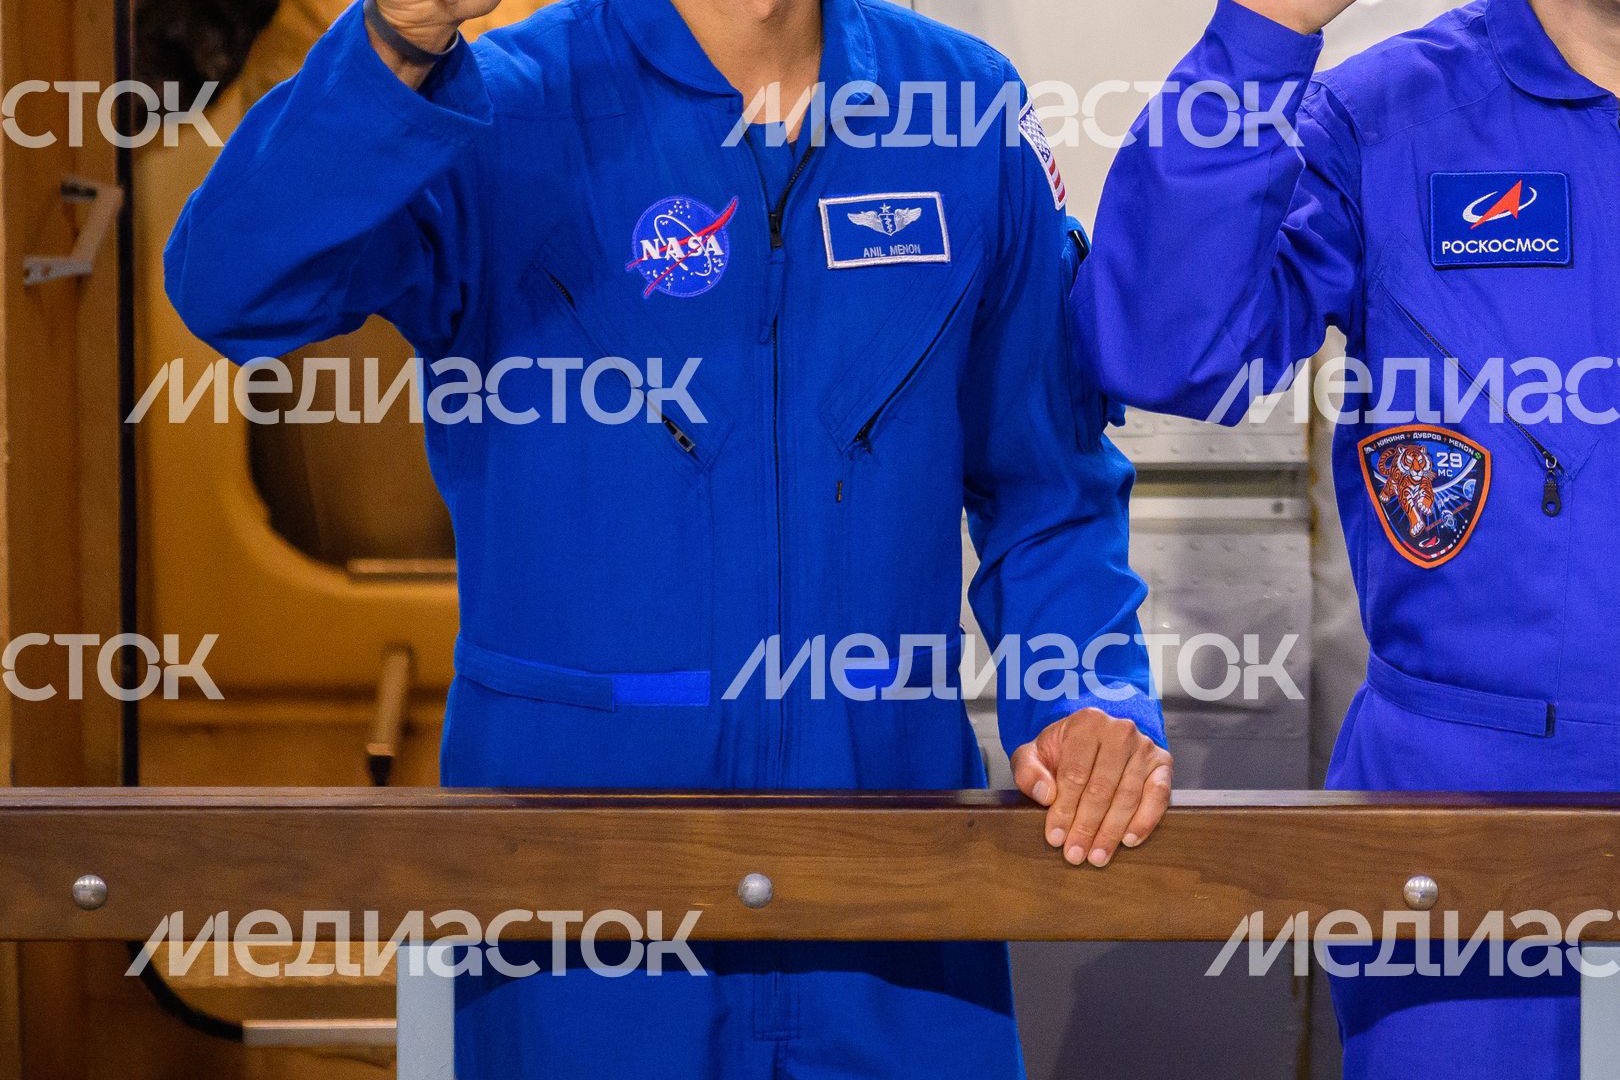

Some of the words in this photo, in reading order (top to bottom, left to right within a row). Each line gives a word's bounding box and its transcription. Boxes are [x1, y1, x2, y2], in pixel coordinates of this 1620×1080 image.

[640, 234, 725, 261] NASA
[863, 247, 886, 258] ANIL
[889, 244, 921, 256] MENON
[1441, 238, 1560, 254] РОСКОСМОС
[1412, 432, 1442, 441] ДУБРОВ
[1448, 438, 1475, 456] MENON
[1436, 452, 1463, 468] 29
